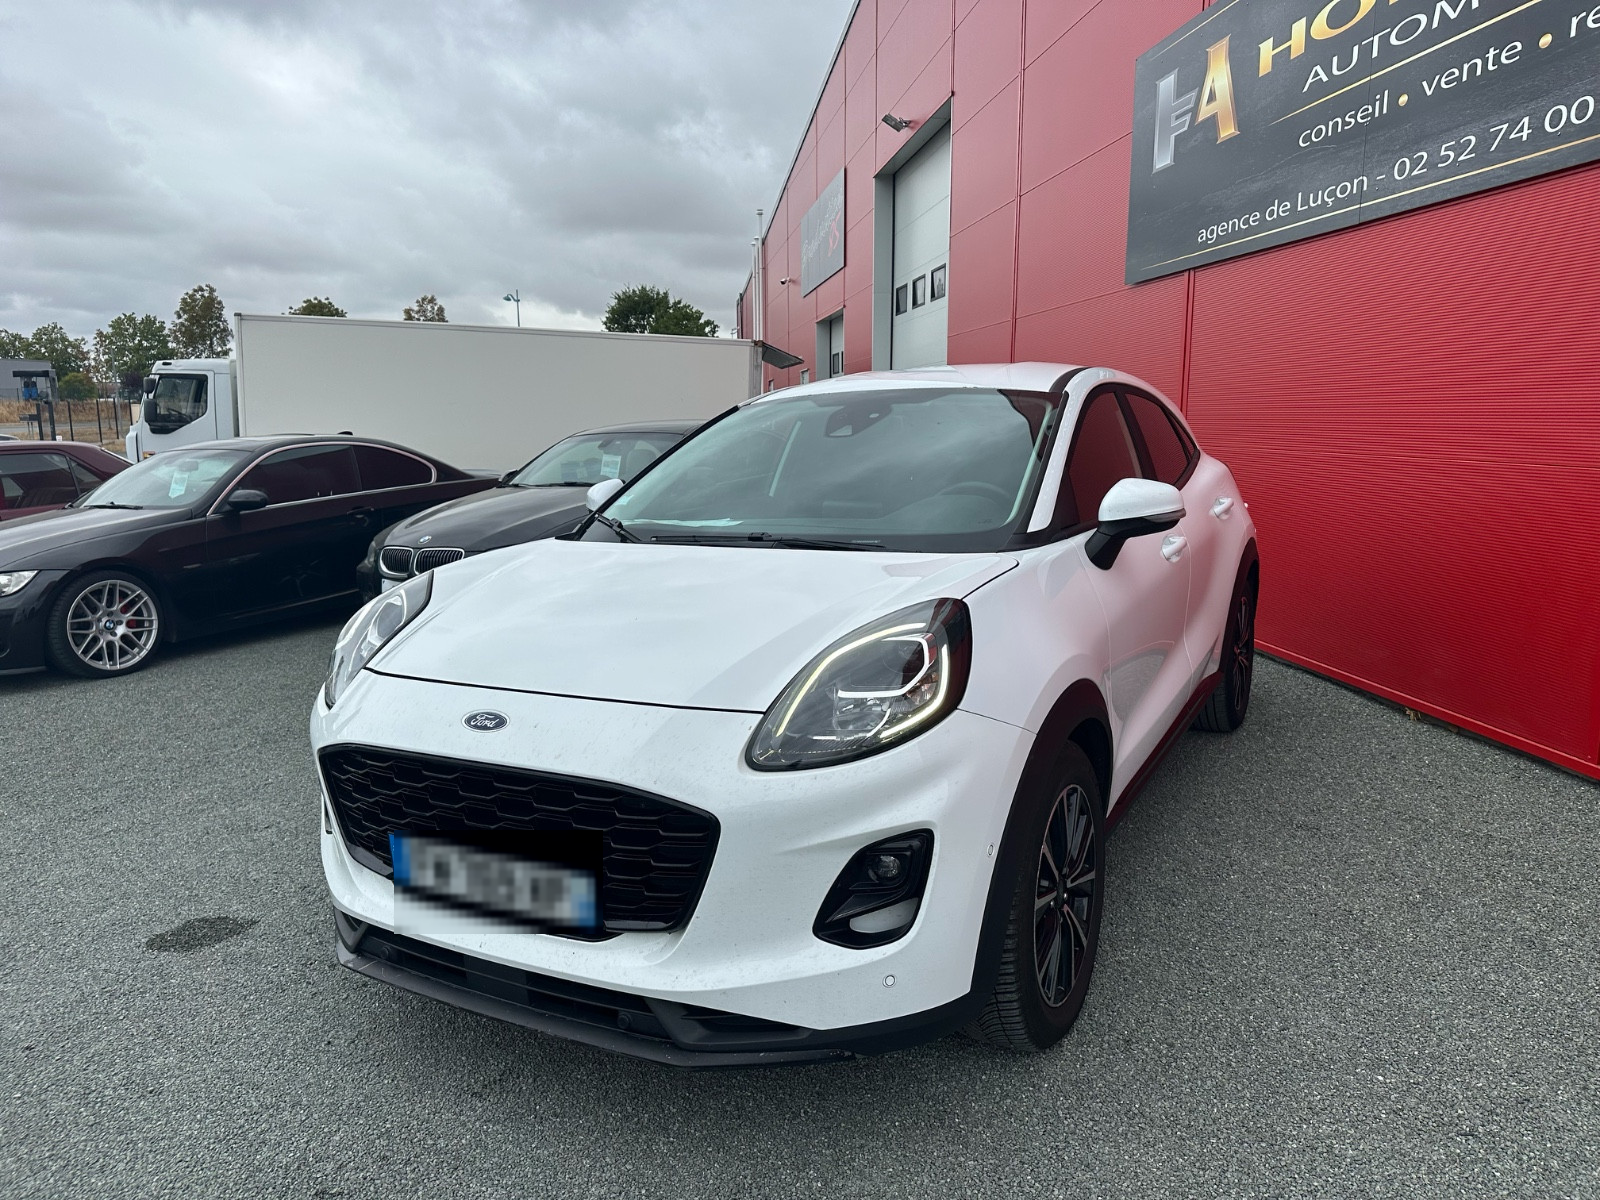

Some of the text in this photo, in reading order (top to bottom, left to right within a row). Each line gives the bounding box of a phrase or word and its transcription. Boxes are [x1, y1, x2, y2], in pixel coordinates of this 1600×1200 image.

[1258, 0, 1399, 78] HO
[1298, 89, 1389, 148] conseil
[1421, 41, 1523, 97] vente
[1197, 211, 1261, 244] agence
[1265, 199, 1291, 221] de
[1296, 175, 1368, 212] Luçon
[1393, 151, 1428, 180] 02
[1437, 135, 1476, 168] 52
[1489, 115, 1533, 152] 74
[1543, 95, 1595, 133] 00
[470, 713, 500, 728] Ford
